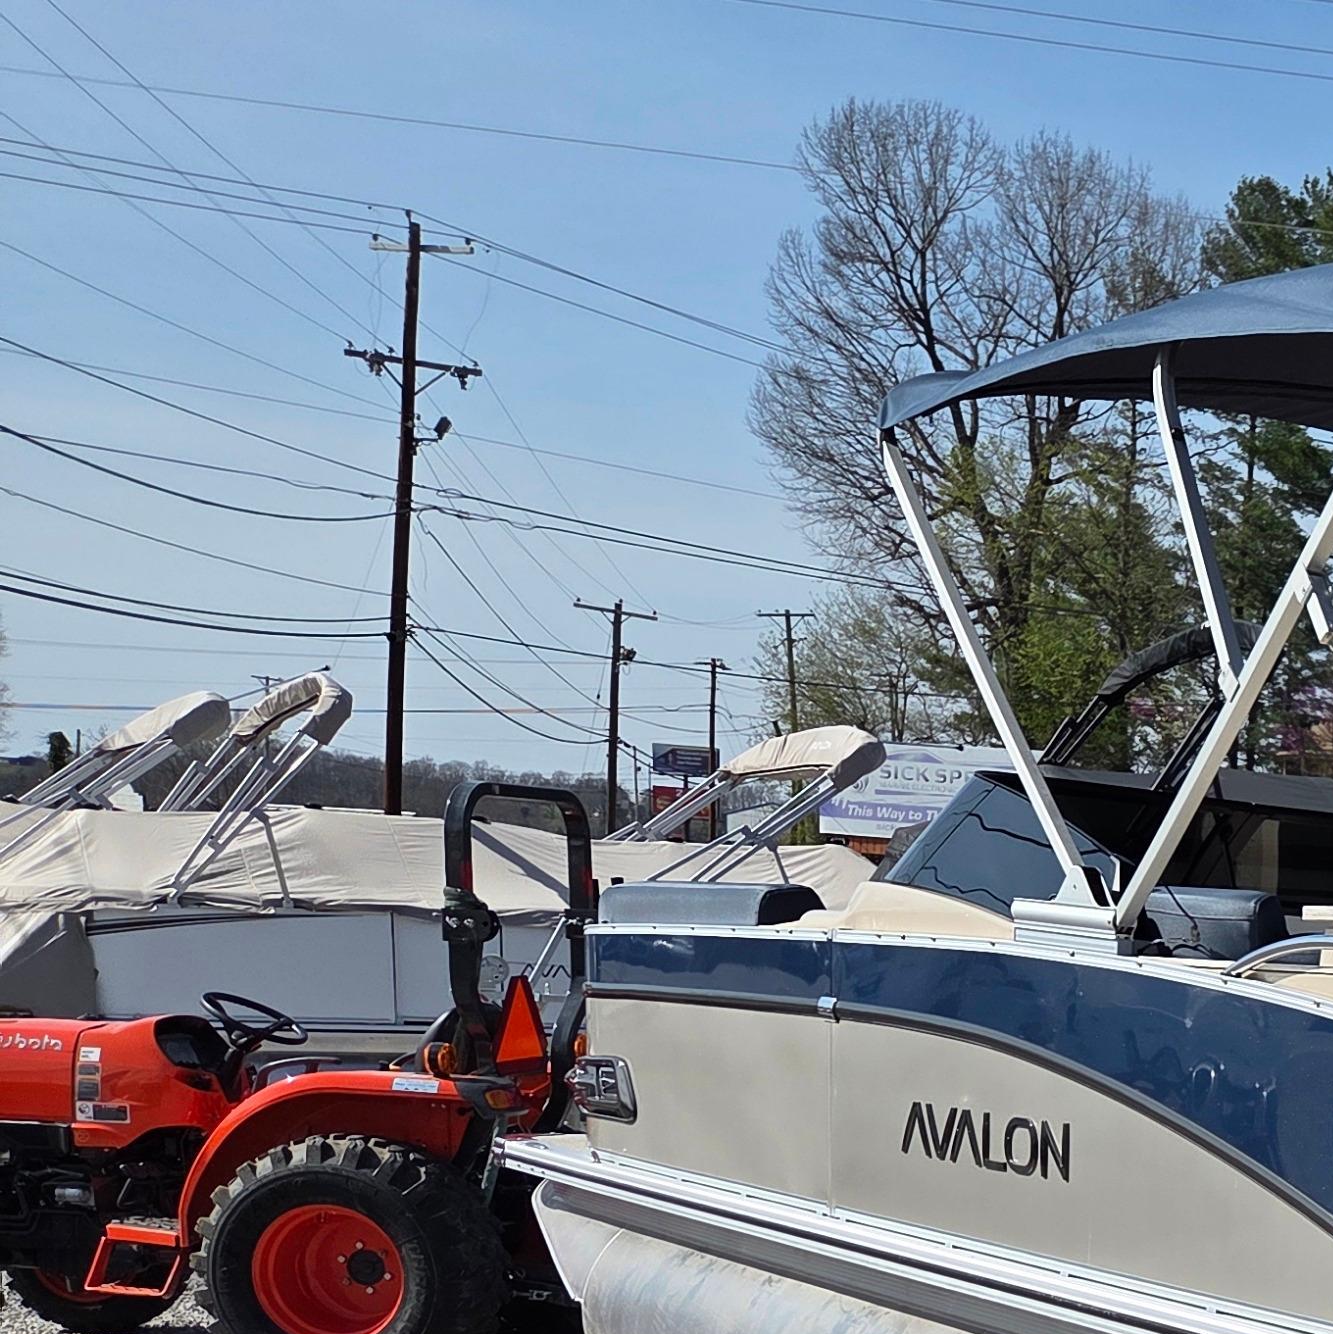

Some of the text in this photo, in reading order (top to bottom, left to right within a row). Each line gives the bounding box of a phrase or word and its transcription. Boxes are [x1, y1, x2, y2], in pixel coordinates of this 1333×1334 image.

[880, 764, 930, 782] SICK
[847, 804, 873, 817] This
[876, 806, 906, 822] Way
[908, 810, 922, 821] to
[901, 1101, 1071, 1183] AVALON
